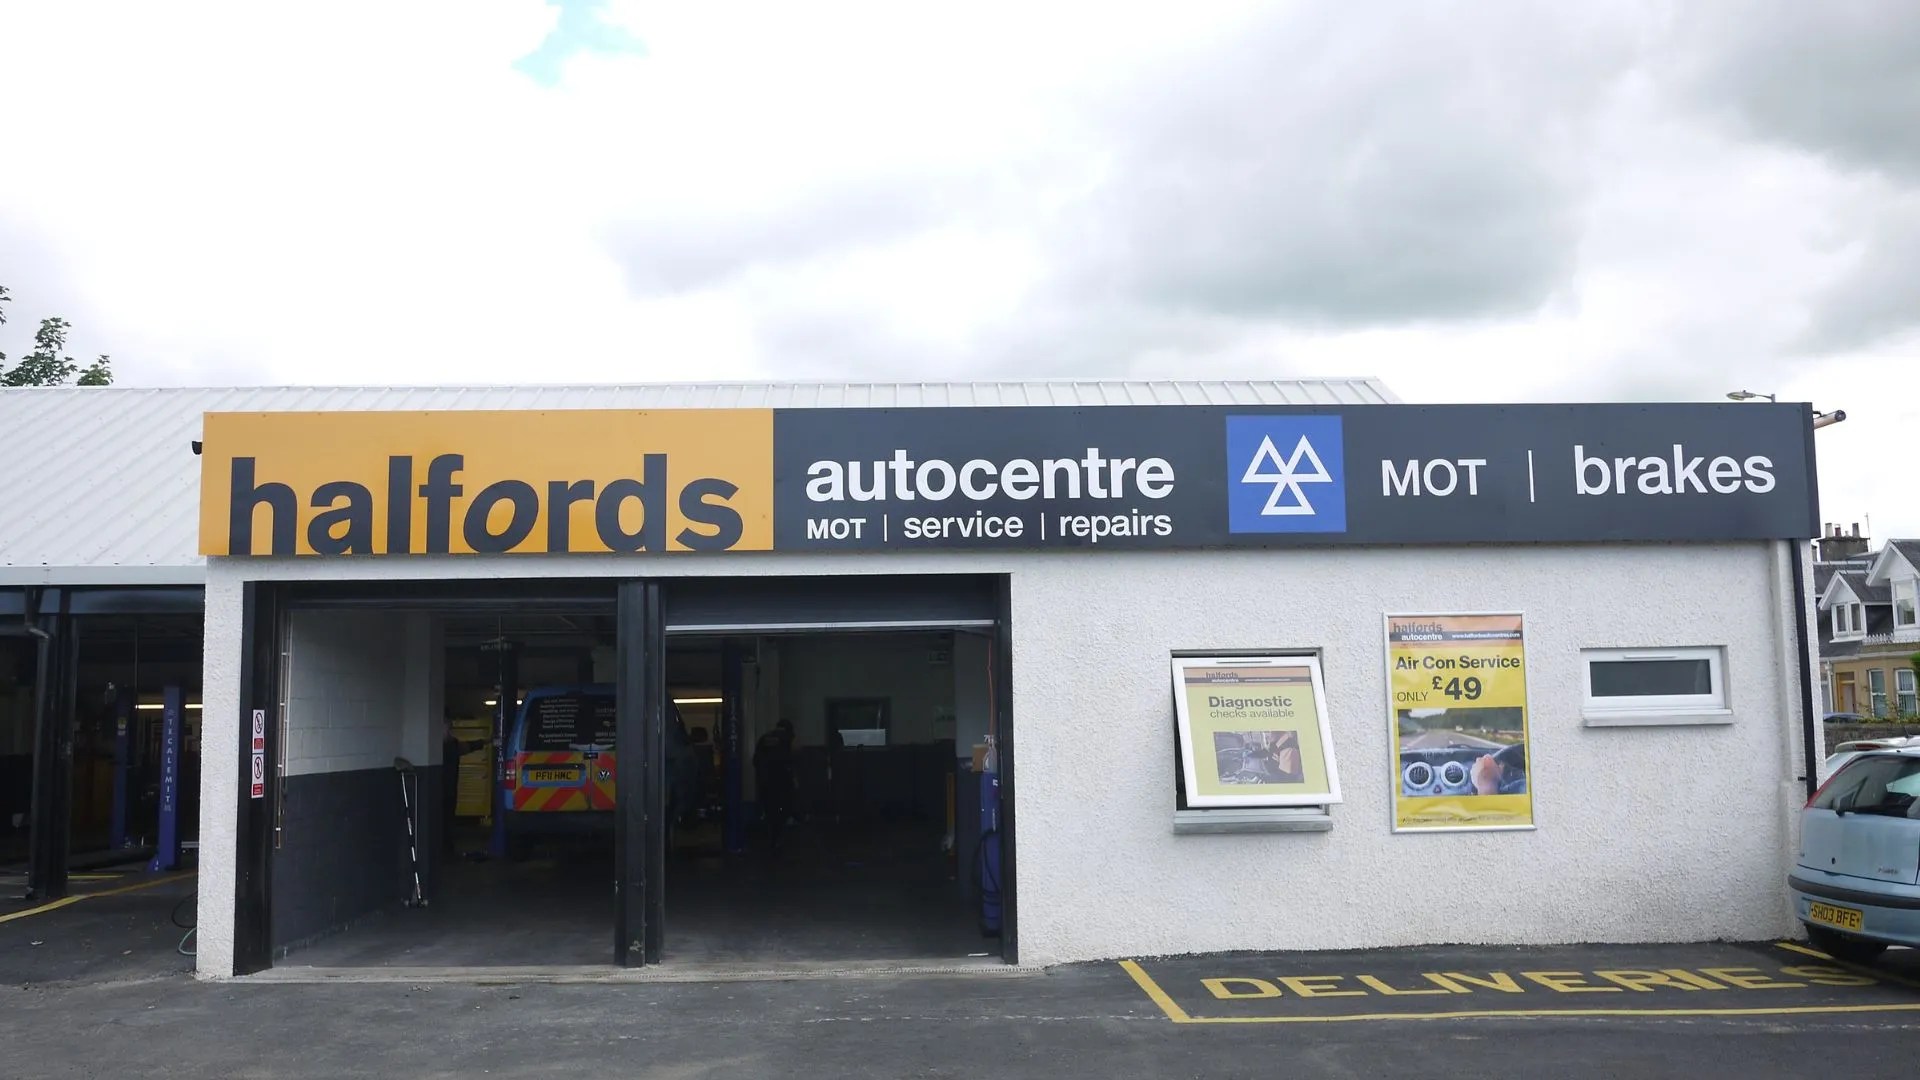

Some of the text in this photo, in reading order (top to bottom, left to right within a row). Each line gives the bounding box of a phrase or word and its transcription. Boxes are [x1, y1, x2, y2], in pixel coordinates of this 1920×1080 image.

[805, 447, 1175, 502] autocentre
[1381, 458, 1487, 496] MOT
[1574, 444, 1776, 495] brakes
[229, 453, 744, 556] halfords
[806, 509, 1173, 543] MOT service repairs
[1393, 622, 1443, 633] halfords
[1401, 633, 1443, 641] autocentre
[1395, 655, 1521, 670] Air Con Service
[1208, 695, 1293, 710] Diagnostic
[1396, 676, 1482, 702] ONLY £49
[1209, 708, 1295, 719] checks available
[164, 718, 173, 803] TECALEMIT
[1813, 907, 1857, 927] SH03 BFE
[1200, 966, 1880, 999] DELIVERIES
